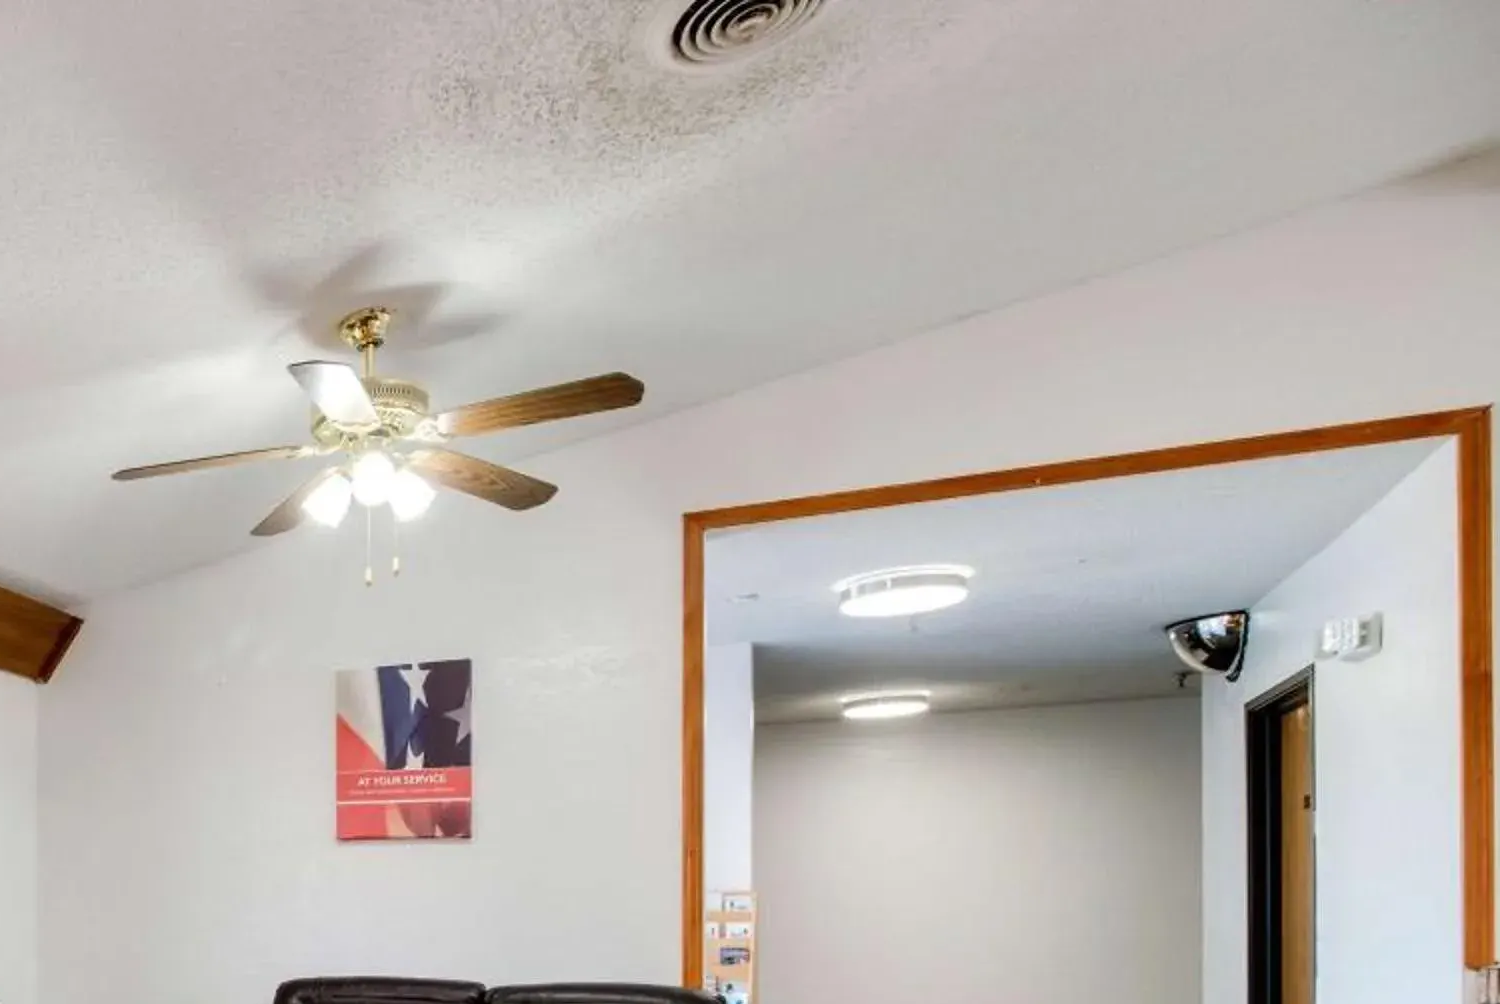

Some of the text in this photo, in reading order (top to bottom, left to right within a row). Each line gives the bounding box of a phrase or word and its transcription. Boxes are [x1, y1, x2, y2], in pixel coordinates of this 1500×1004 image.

[358, 773, 447, 787] AT YOUR SERVICE
